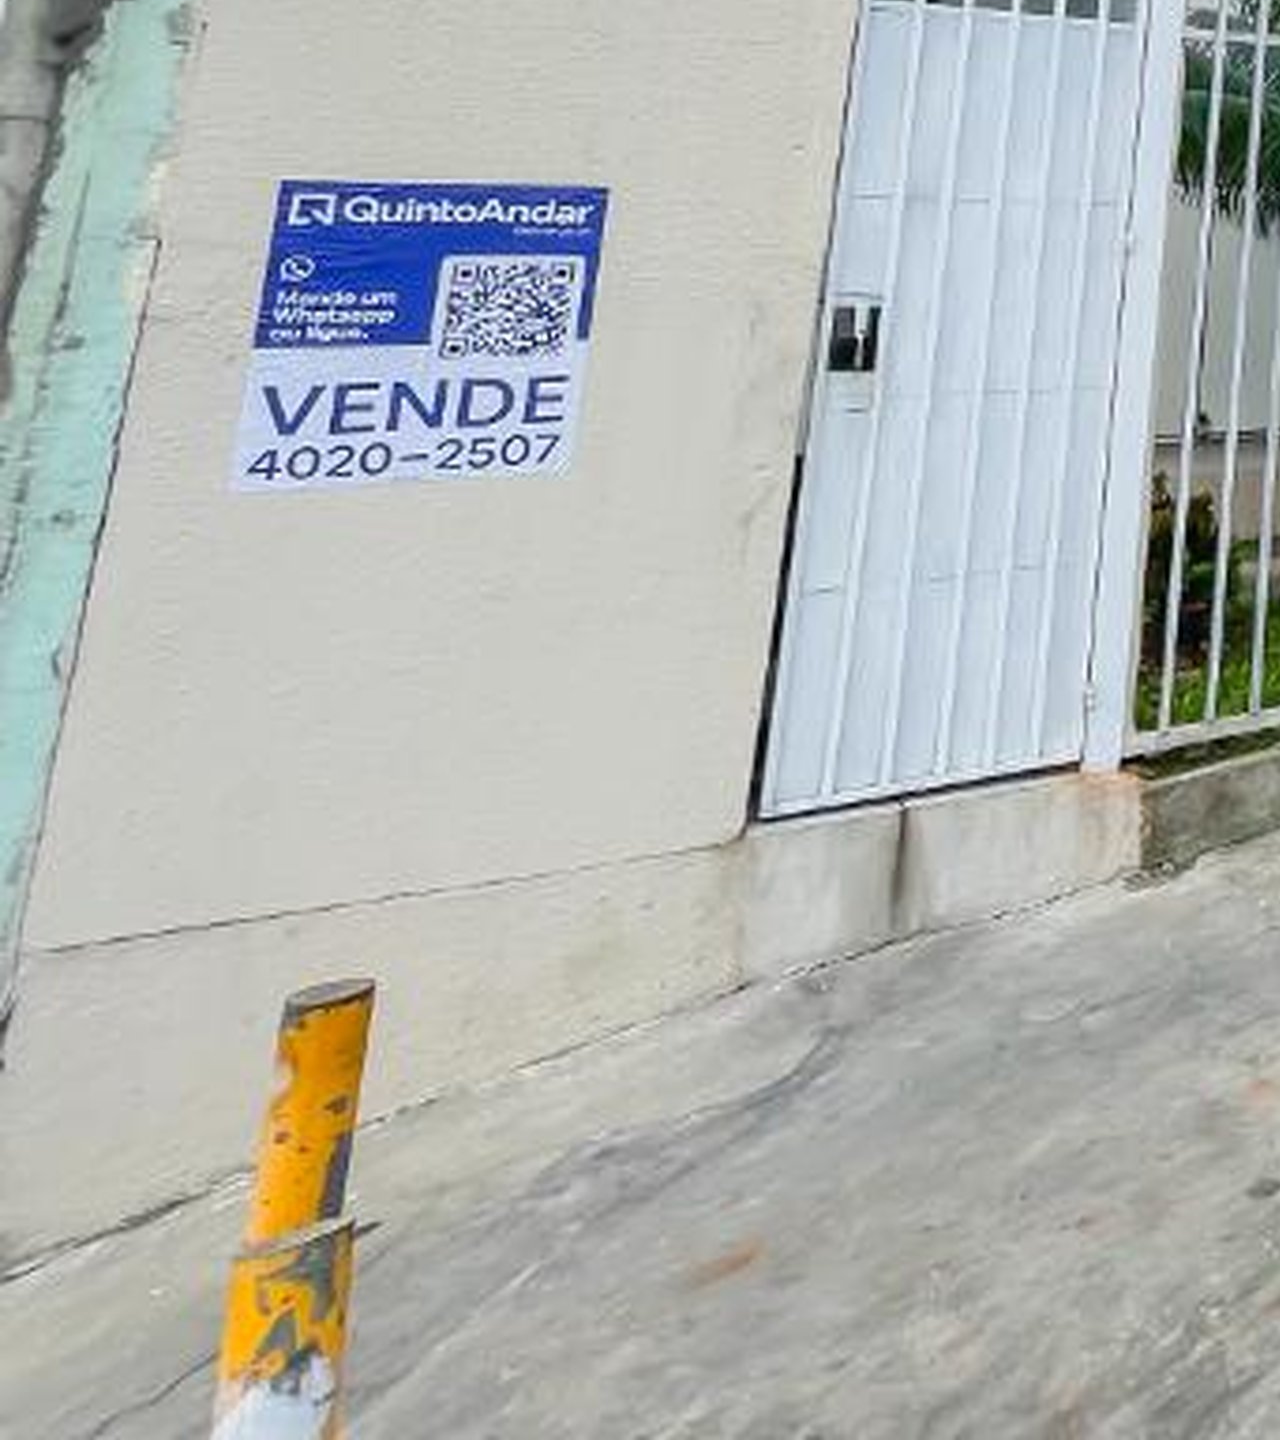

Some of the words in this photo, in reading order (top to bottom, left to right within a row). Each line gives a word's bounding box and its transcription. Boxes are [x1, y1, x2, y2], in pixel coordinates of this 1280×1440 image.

[344, 196, 595, 226] QuintoAndar
[262, 375, 570, 437] VENDE
[247, 434, 562, 480] 4020-2507
